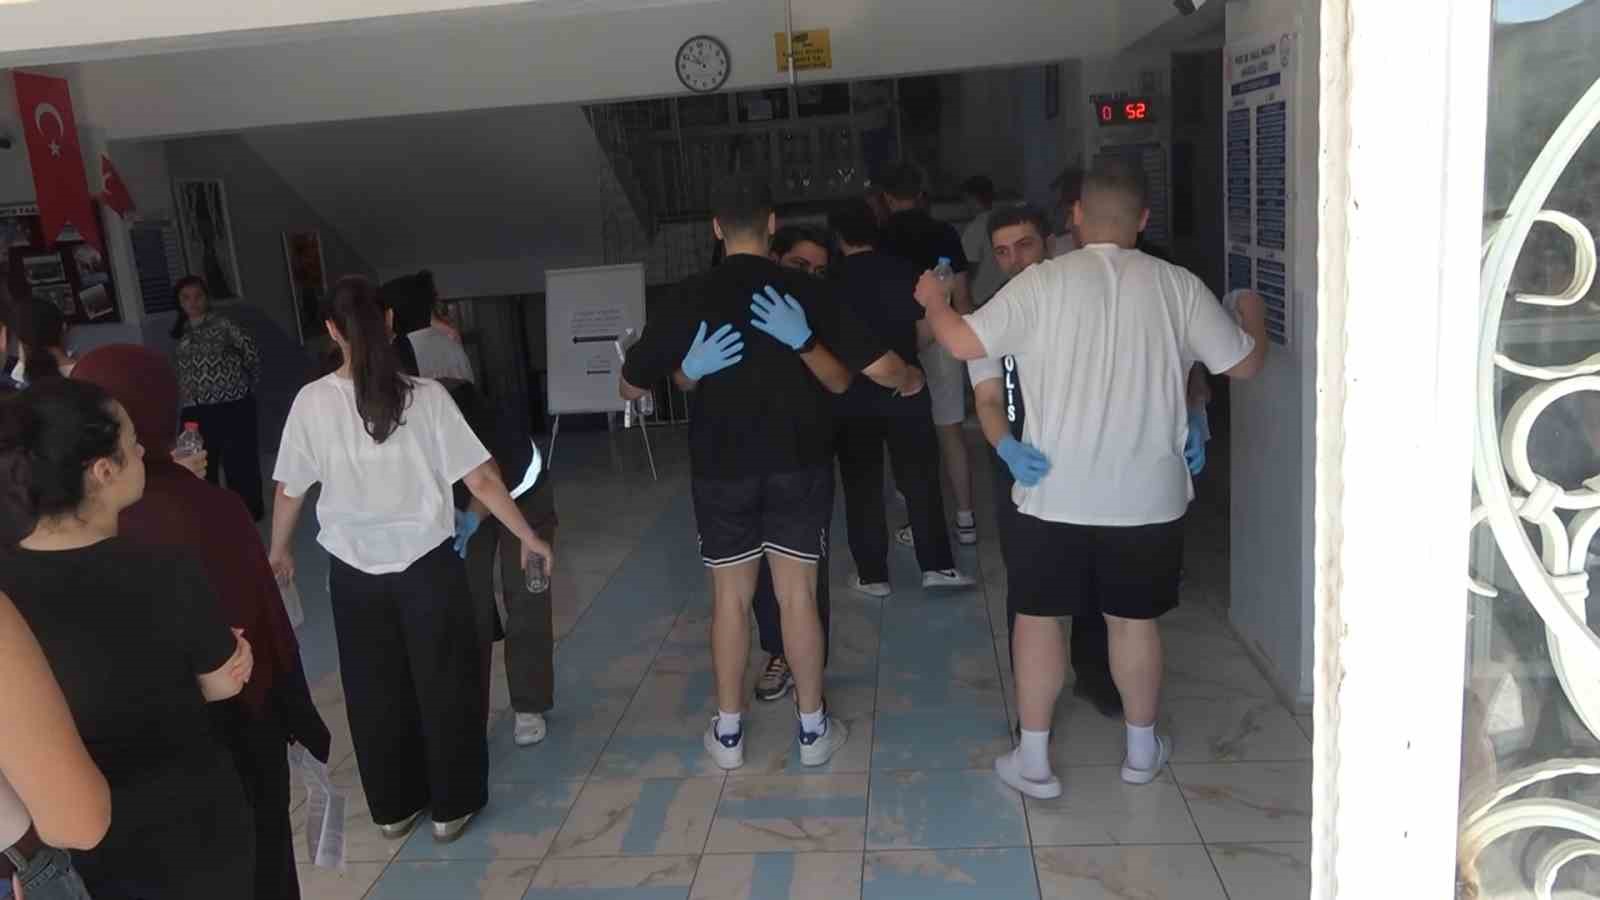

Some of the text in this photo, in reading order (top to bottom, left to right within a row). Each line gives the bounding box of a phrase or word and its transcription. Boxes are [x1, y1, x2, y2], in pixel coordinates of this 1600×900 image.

[1102, 103, 1146, 120] 0 52
[1004, 355, 1016, 422] OLİS
